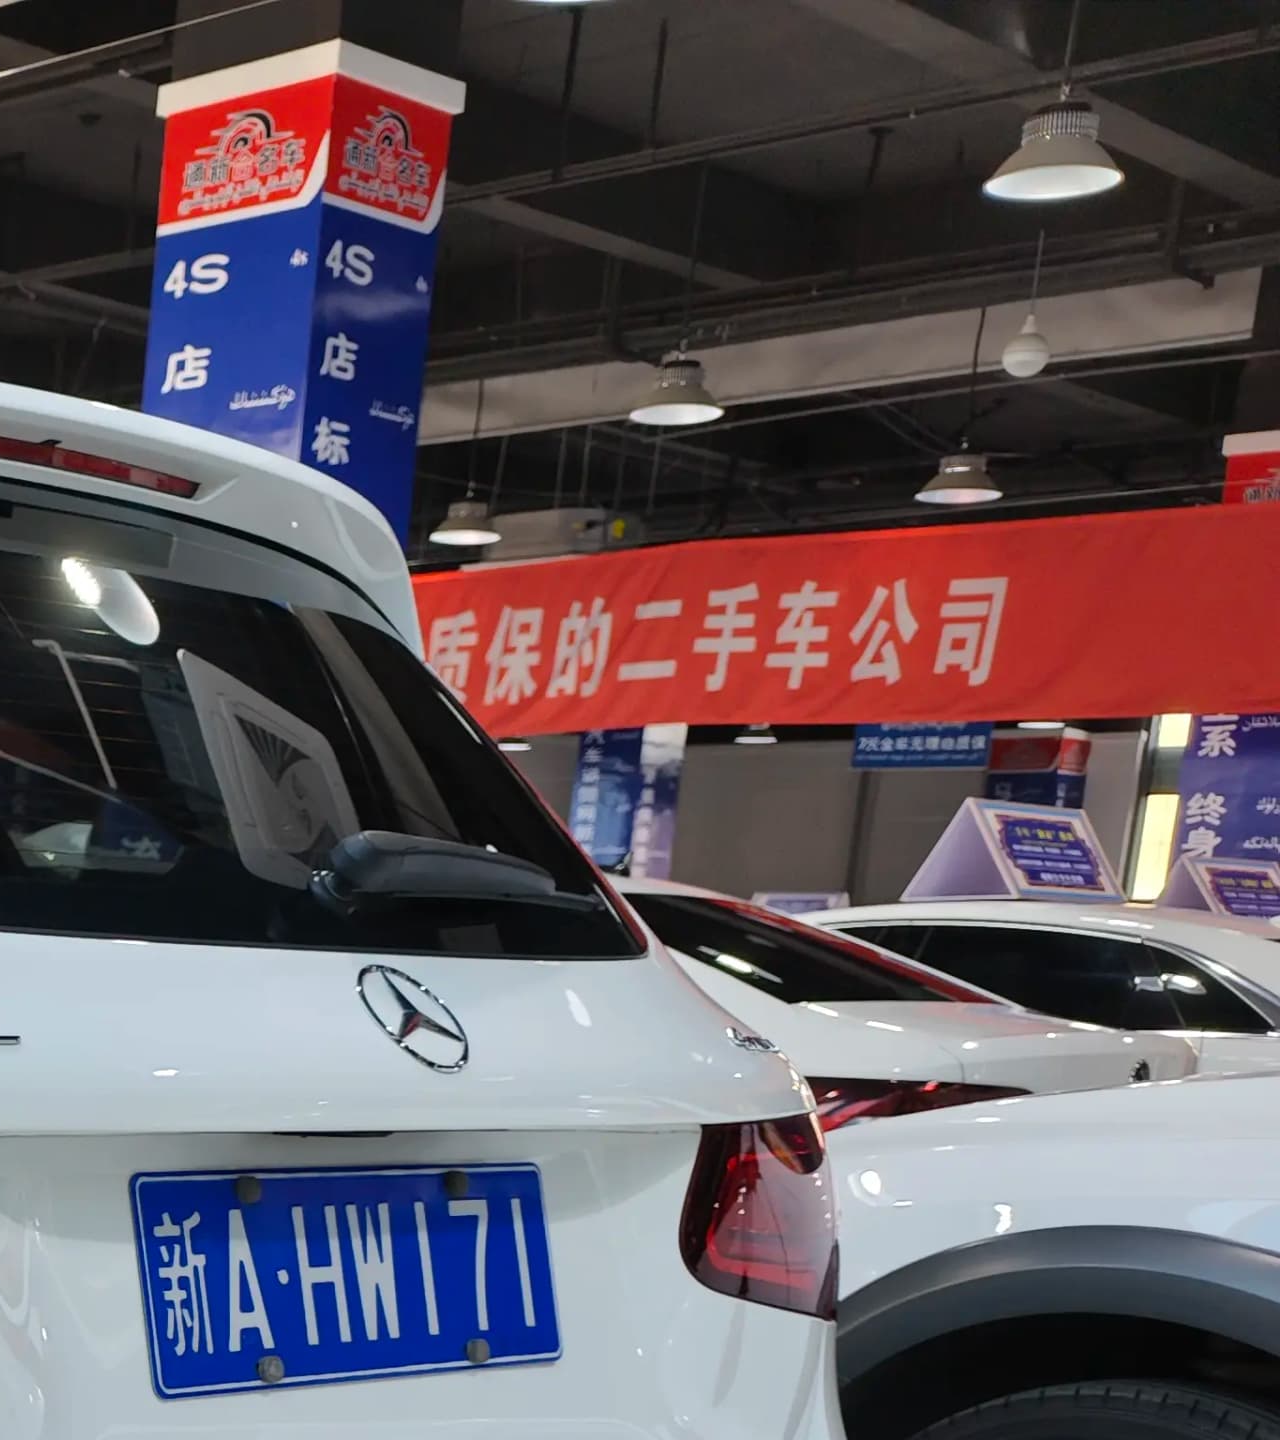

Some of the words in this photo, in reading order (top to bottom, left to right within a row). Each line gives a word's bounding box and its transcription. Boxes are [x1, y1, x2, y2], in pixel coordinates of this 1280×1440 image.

[428, 576, 1008, 706] 质保的二手车公司
[151, 1197, 538, 1357] 新A·HW171
